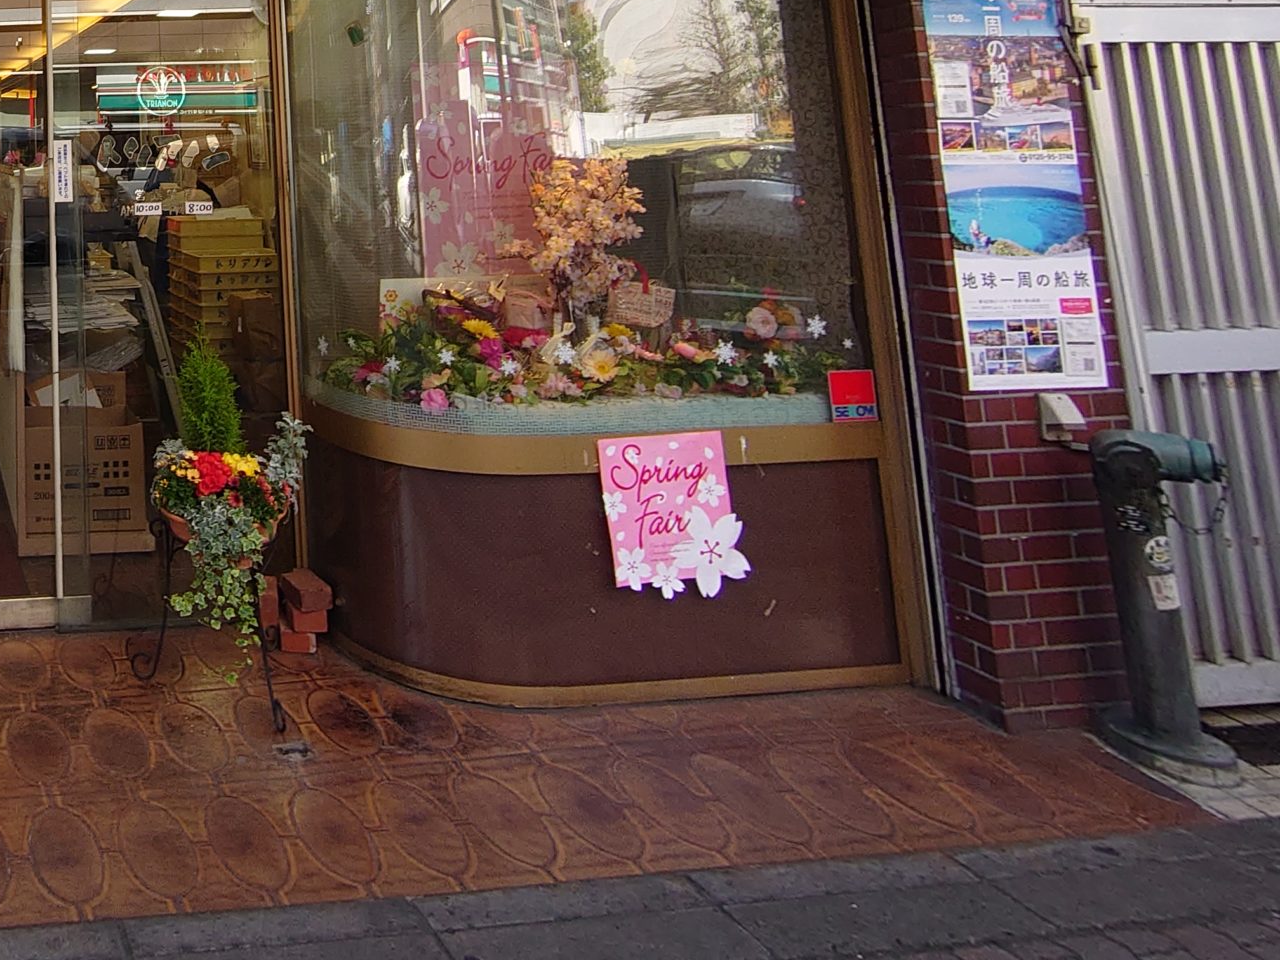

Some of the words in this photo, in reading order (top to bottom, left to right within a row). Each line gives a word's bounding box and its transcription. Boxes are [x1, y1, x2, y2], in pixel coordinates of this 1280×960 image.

[146, 99, 178, 108] TRIANON
[426, 134, 520, 191] Spring
[135, 204, 160, 213] 10:00
[188, 203, 212, 213] 8:00
[961, 270, 1091, 289] 地球一周の船旅
[610, 444, 708, 503] Spring
[635, 493, 691, 549] Fair
